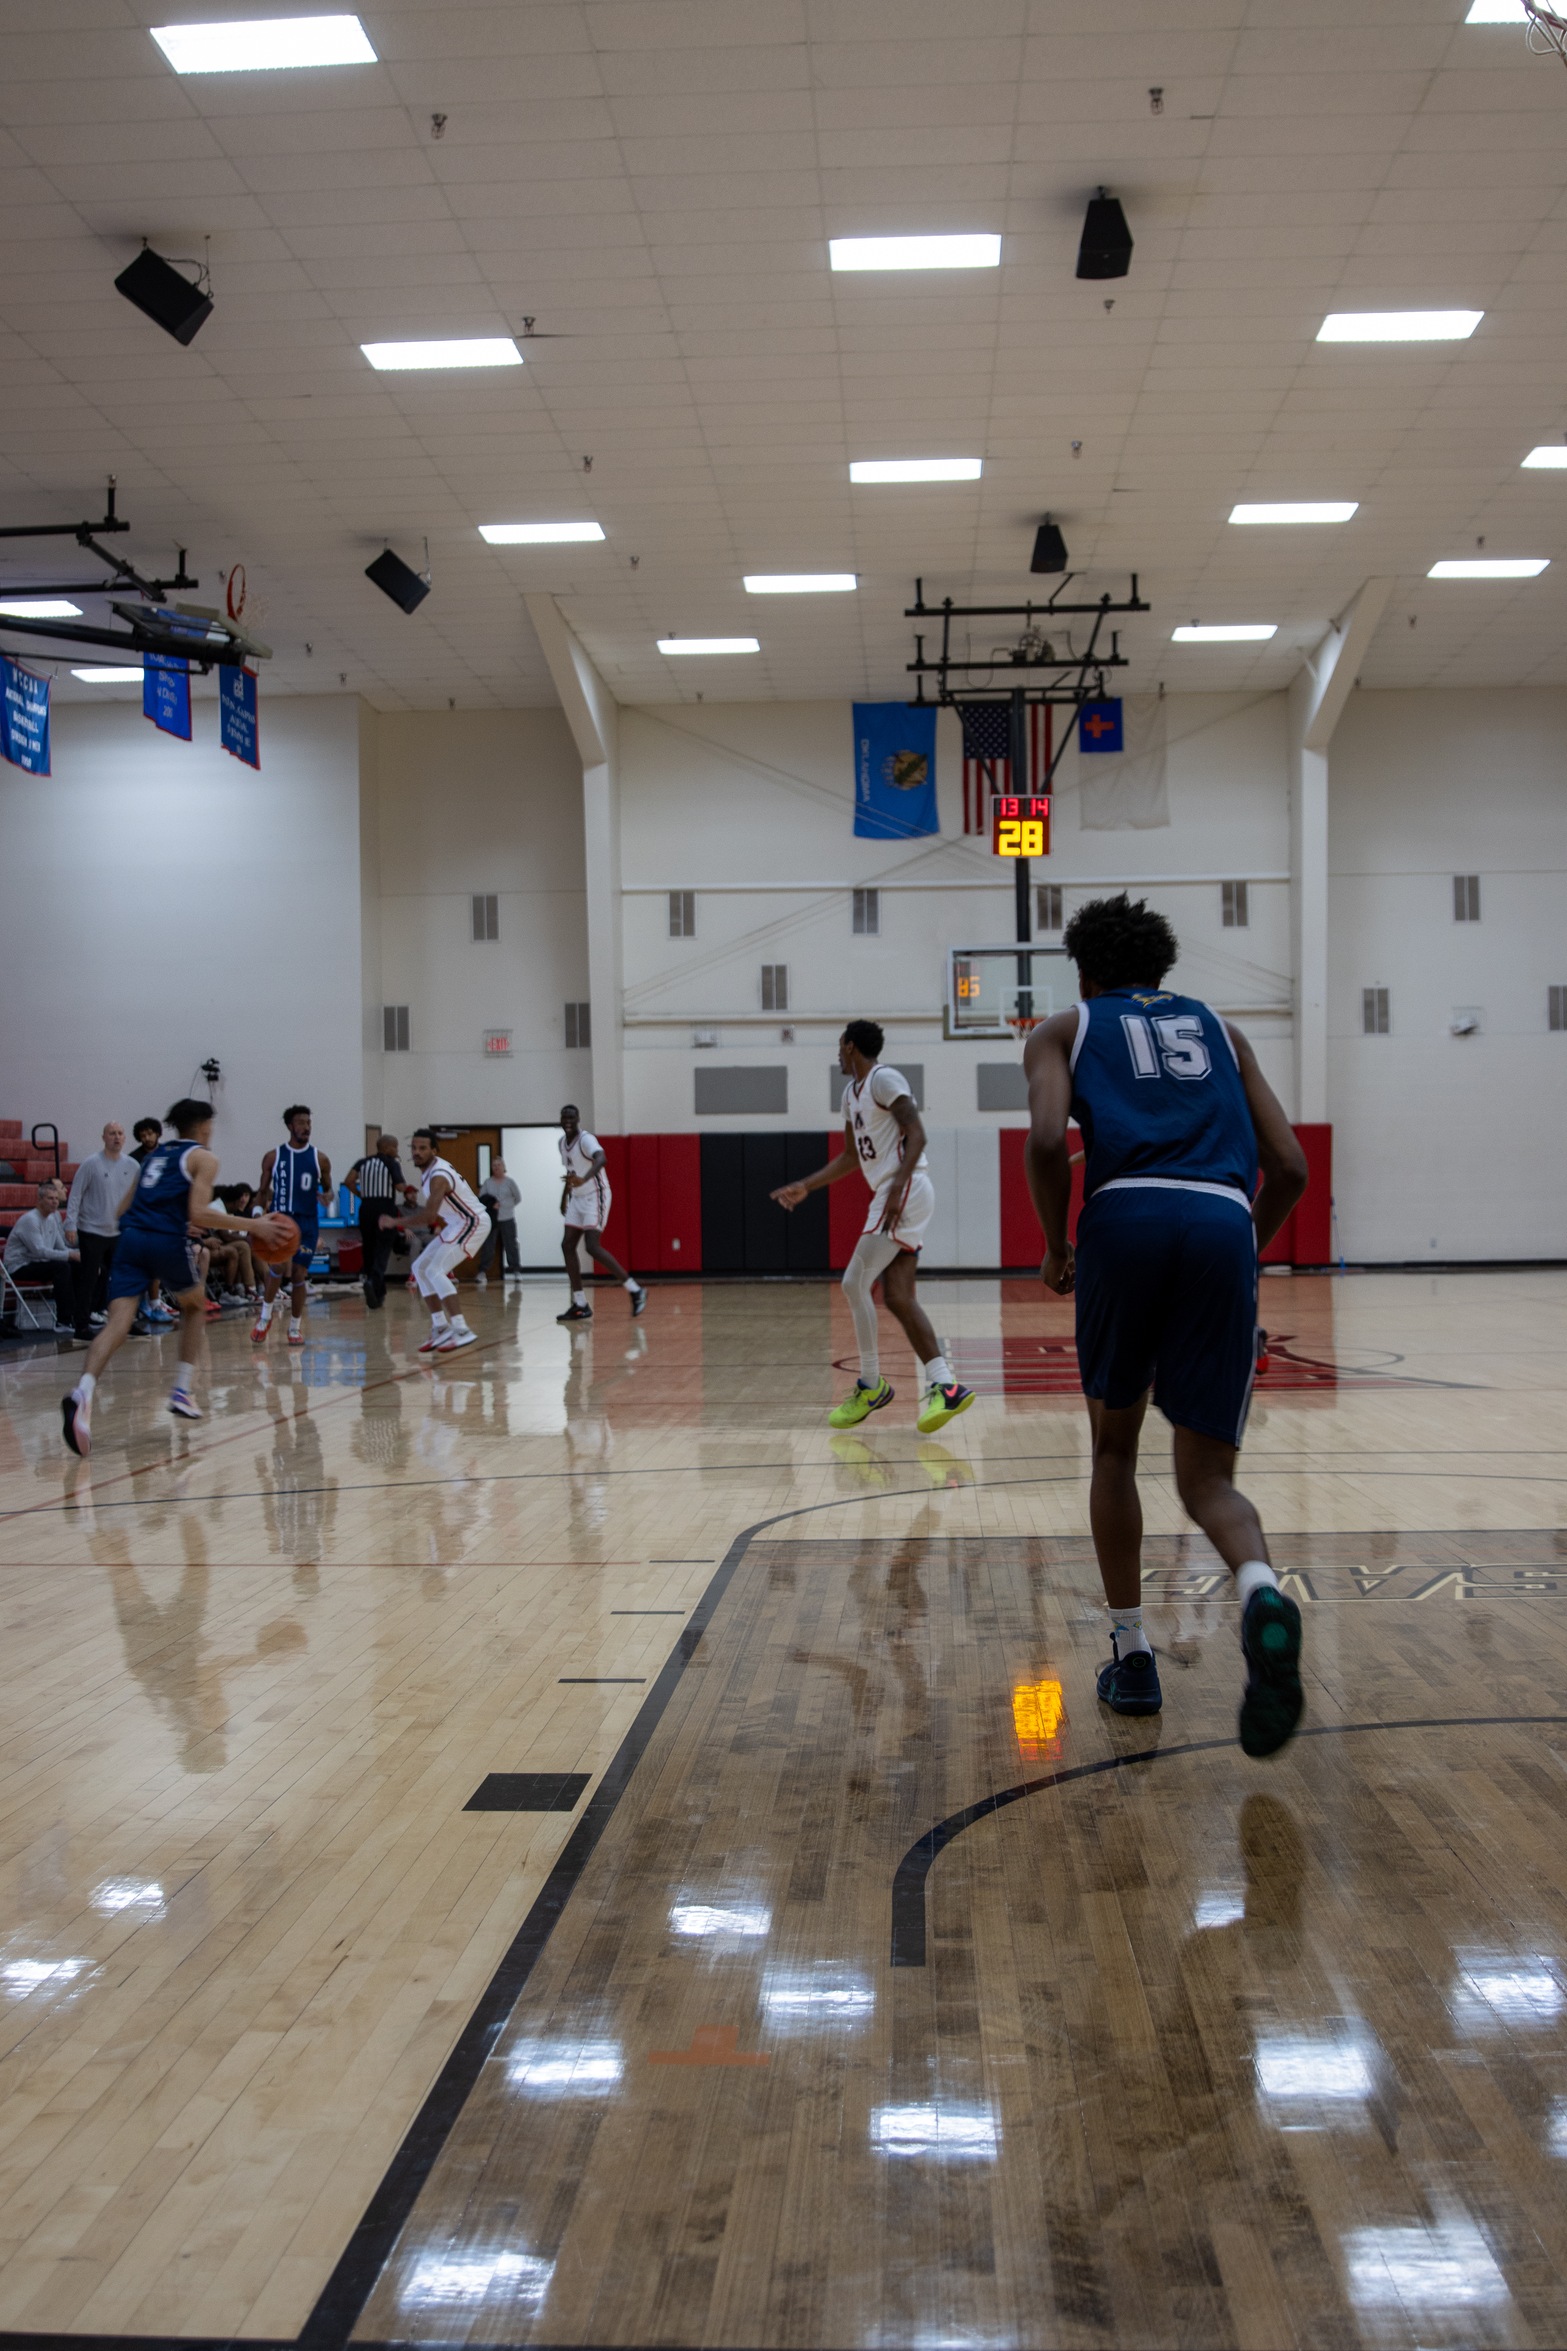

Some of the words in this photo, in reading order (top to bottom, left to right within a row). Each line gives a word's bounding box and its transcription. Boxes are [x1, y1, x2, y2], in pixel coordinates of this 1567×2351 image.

[999, 798, 1019, 817] 13
[1029, 798, 1049, 817] 14
[998, 820, 1044, 857] 28
[490, 1037, 508, 1051] EXIT
[1119, 1013, 1213, 1081] 15
[857, 1135, 876, 1161] 13
[140, 1157, 169, 1188] 5
[301, 1172, 313, 1191] 0
